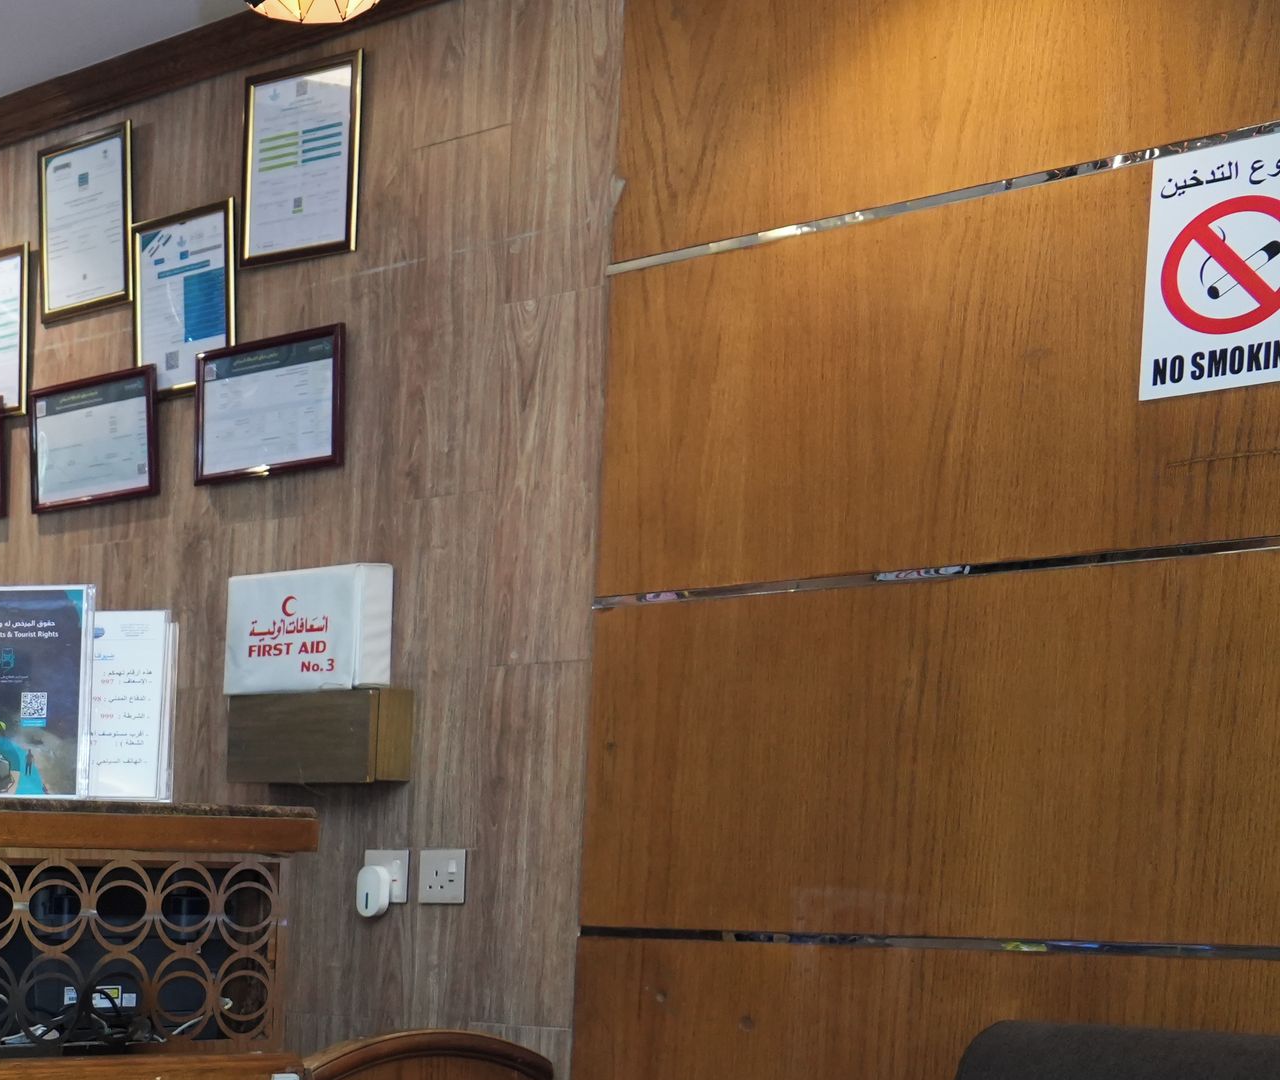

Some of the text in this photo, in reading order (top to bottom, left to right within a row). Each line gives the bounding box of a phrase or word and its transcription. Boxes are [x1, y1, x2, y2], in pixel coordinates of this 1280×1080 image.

[1160, 160, 1239, 200] التدخين
[1152, 354, 1185, 386] NO
[11, 620, 36, 628] المرخص
[38, 630, 59, 639] Rights
[248, 640, 326, 658] FIRST AID
[301, 658, 335, 672] No. 3
